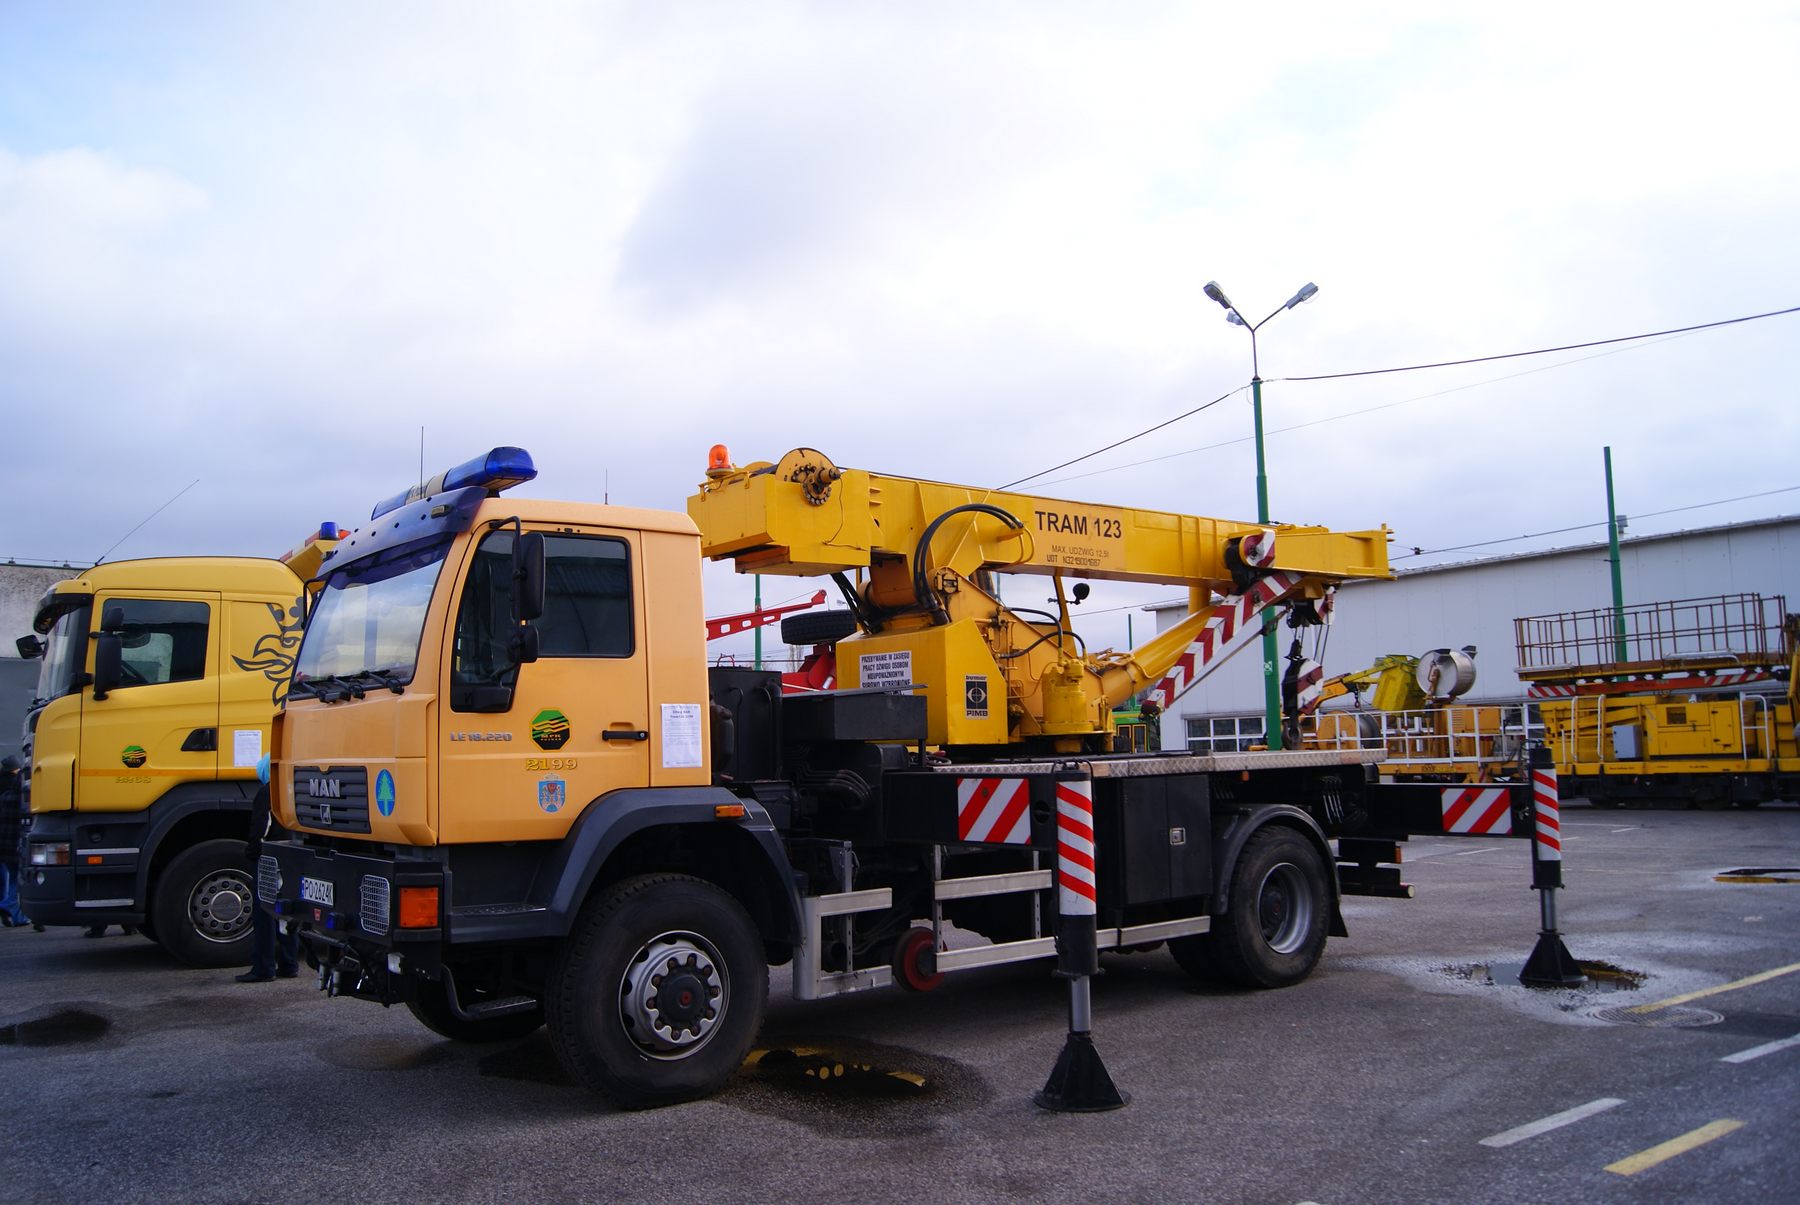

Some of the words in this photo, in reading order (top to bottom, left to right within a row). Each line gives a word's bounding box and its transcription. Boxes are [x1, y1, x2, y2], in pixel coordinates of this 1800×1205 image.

[1035, 510, 1088, 536] TRAM
[1094, 517, 1122, 539] 123
[1046, 554, 1058, 563] UDT
[526, 758, 578, 771] 2199
[309, 779, 341, 798] MAN
